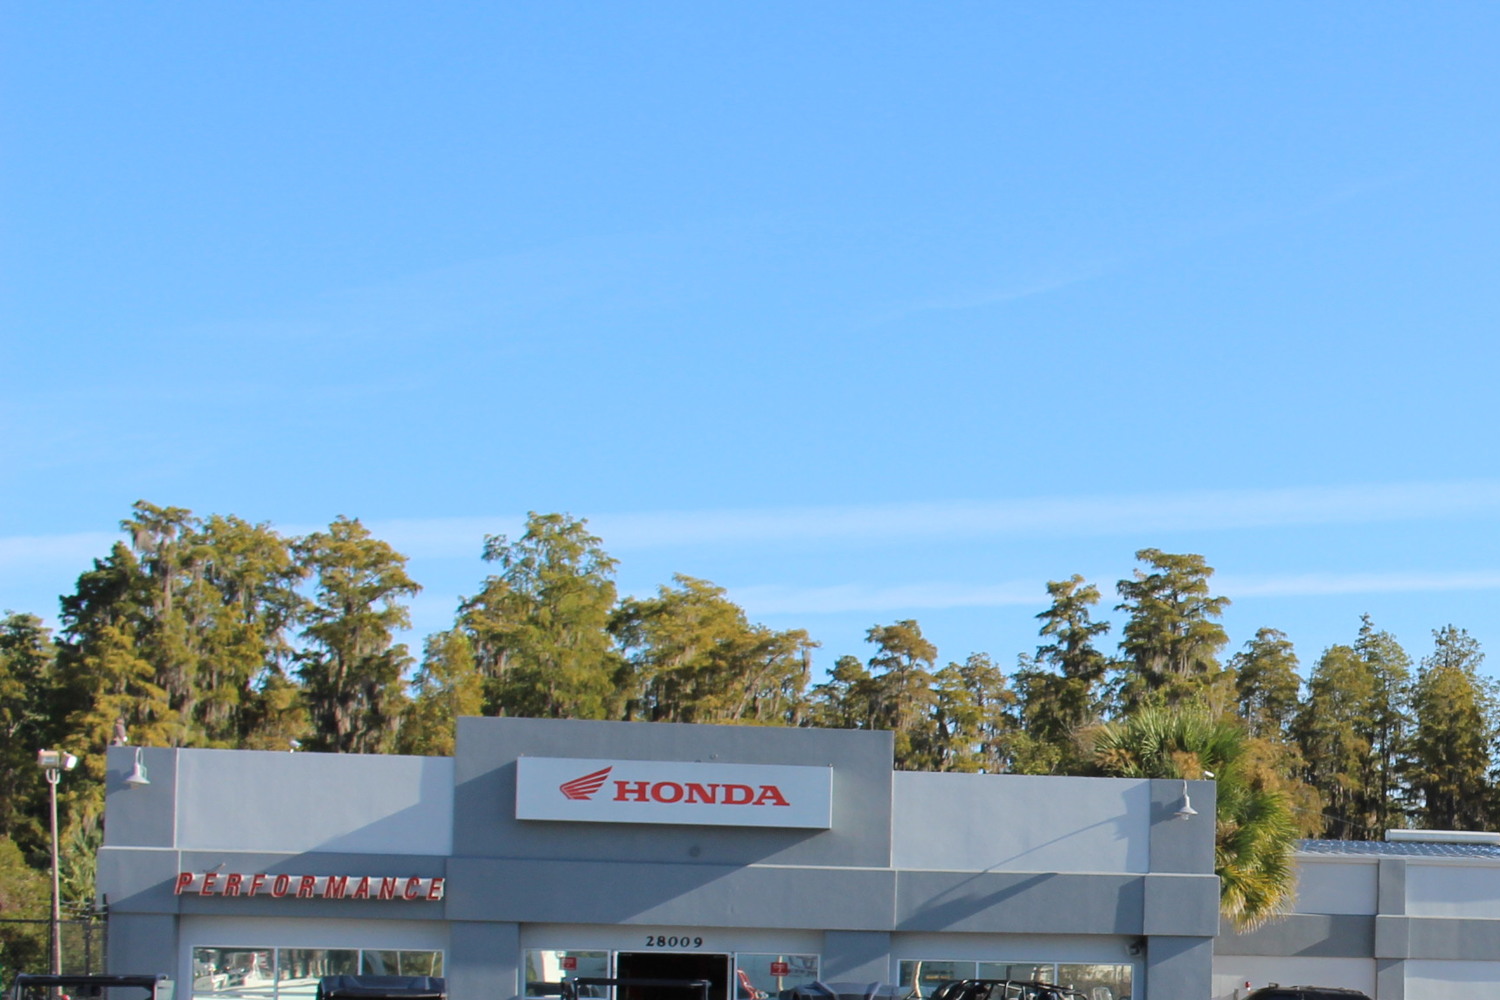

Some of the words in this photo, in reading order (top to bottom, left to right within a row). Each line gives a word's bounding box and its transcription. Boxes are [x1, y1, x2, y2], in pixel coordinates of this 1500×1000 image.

[613, 781, 790, 806] HONDA
[174, 872, 444, 900] PERFORMANCE
[645, 936, 703, 949] 28009
